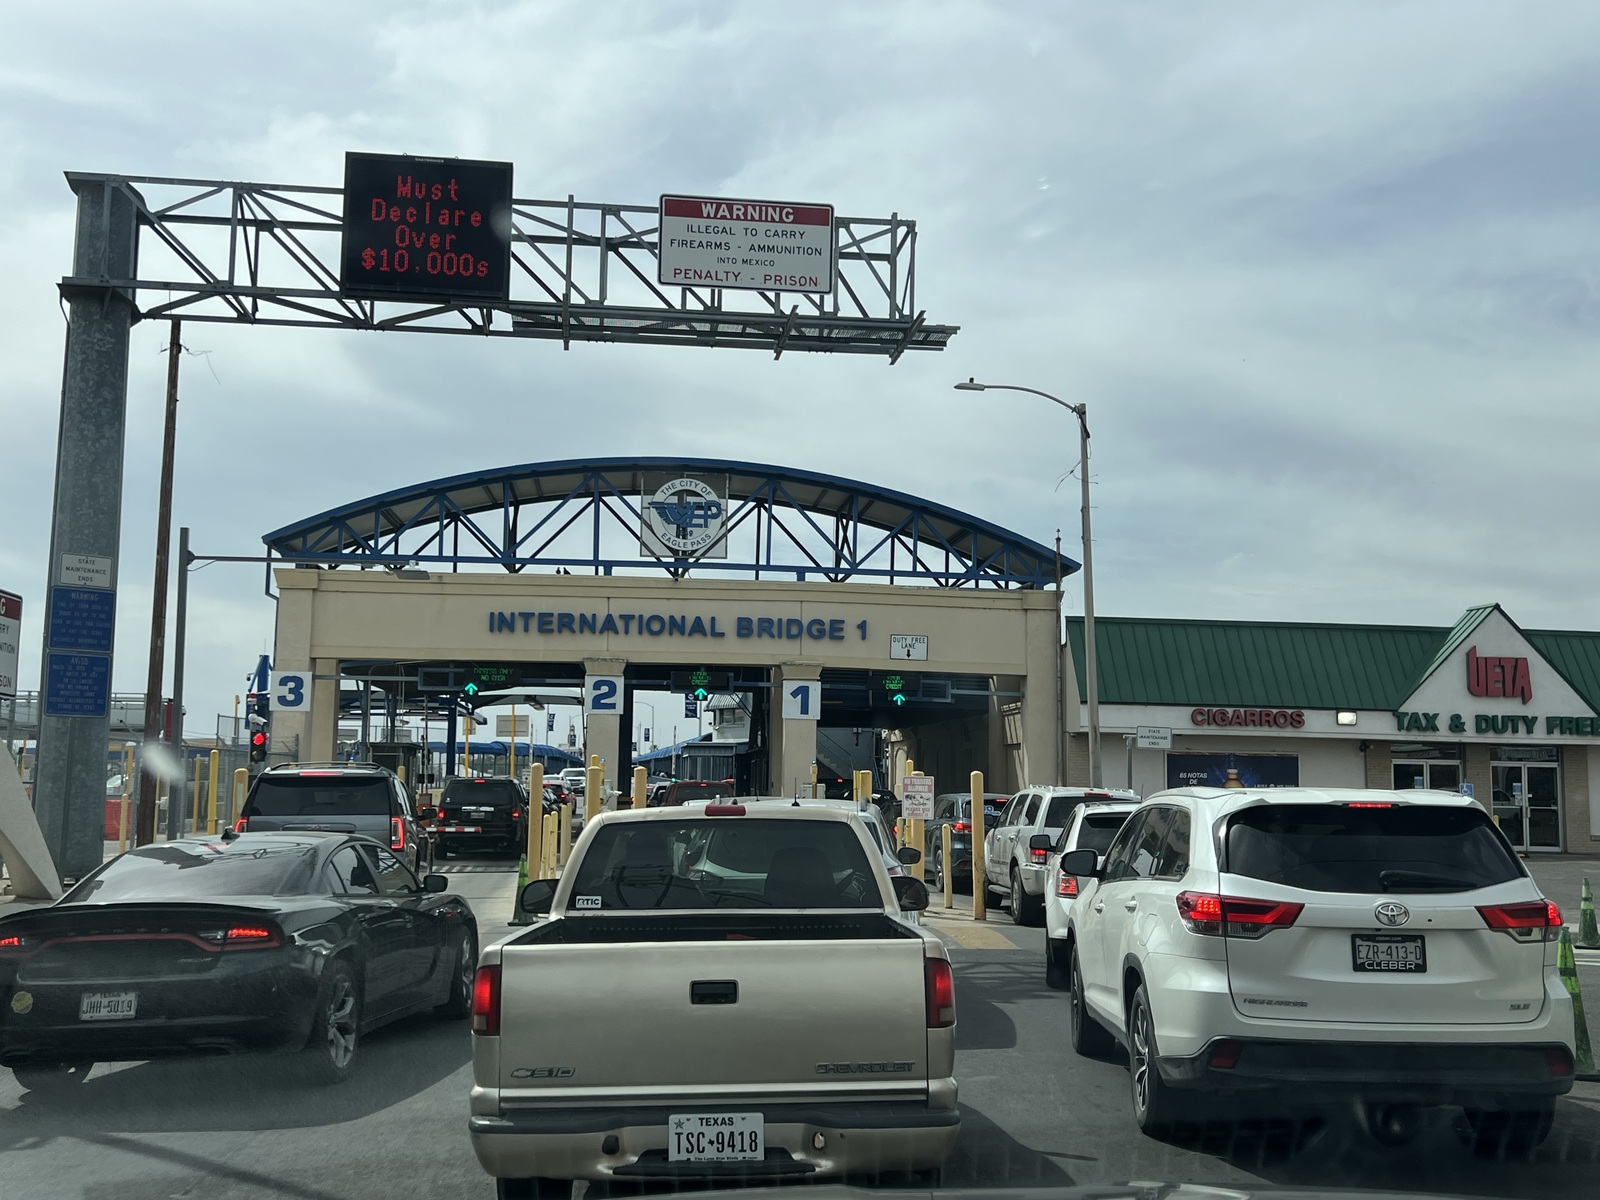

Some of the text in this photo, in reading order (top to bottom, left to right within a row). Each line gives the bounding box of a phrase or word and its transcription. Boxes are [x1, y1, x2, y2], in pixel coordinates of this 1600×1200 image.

[397, 176, 458, 200] Must
[371, 198, 482, 227] Declare
[701, 202, 794, 222] WARNING
[395, 224, 456, 250] Over
[686, 224, 806, 240] ILLEGAL TO CARRY
[670, 239, 731, 250] FIREARMS
[748, 244, 822, 256] AMMUNITION
[362, 247, 488, 277] $10,000s
[742, 258, 776, 267] MEXICO
[673, 268, 742, 282] PENALTY
[763, 274, 818, 287] PRISON
[660, 480, 712, 497] THE CITY OF
[660, 532, 688, 548] EAGLE
[690, 533, 712, 548] PASS
[66, 566, 107, 576] MAINTENANCE
[489, 612, 868, 640] INTERNATIONAL BRIDGE 1
[1466, 646, 1532, 705] UETA
[277, 676, 304, 707] 3
[592, 680, 618, 710] 2
[790, 686, 809, 715] 1
[1192, 708, 1306, 728] CIGARROS
[1393, 712, 1600, 736] TAX & DUTY FREE
[1357, 945, 1422, 960] EZR-413-D
[1365, 960, 1416, 970] CLEBER
[816, 1061, 915, 1074] CHEVROLET
[698, 1117, 734, 1126] TEXAS
